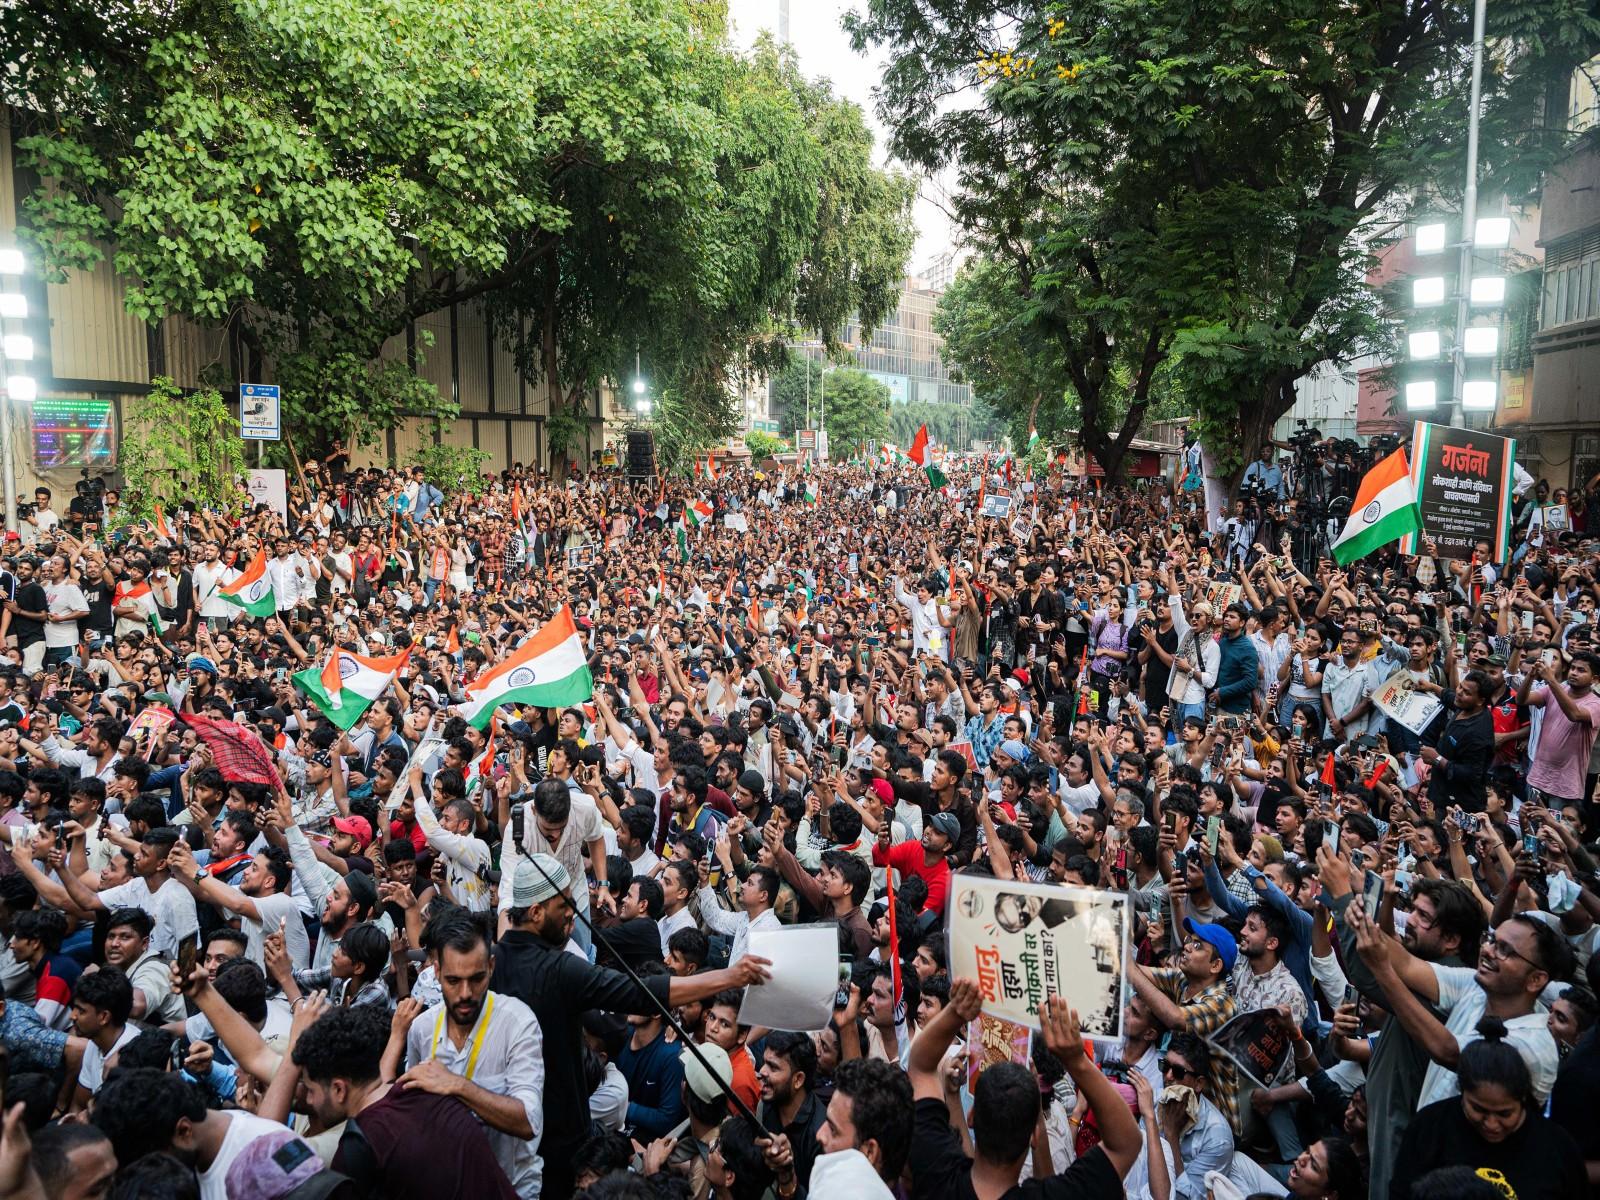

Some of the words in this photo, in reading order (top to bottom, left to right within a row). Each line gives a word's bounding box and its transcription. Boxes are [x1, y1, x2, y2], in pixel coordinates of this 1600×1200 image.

[1442, 443, 1489, 477] गर्जना
[1432, 474, 1458, 489] लोकशाही
[1458, 478, 1473, 491] आणि
[1473, 480, 1493, 493] संविधान
[1024, 932, 1037, 949] वर
[1001, 960, 1023, 999] तुझा
[1044, 960, 1055, 982] नाय
[993, 1020, 1003, 1037] 2
[981, 1028, 1012, 1062] Ajwain
